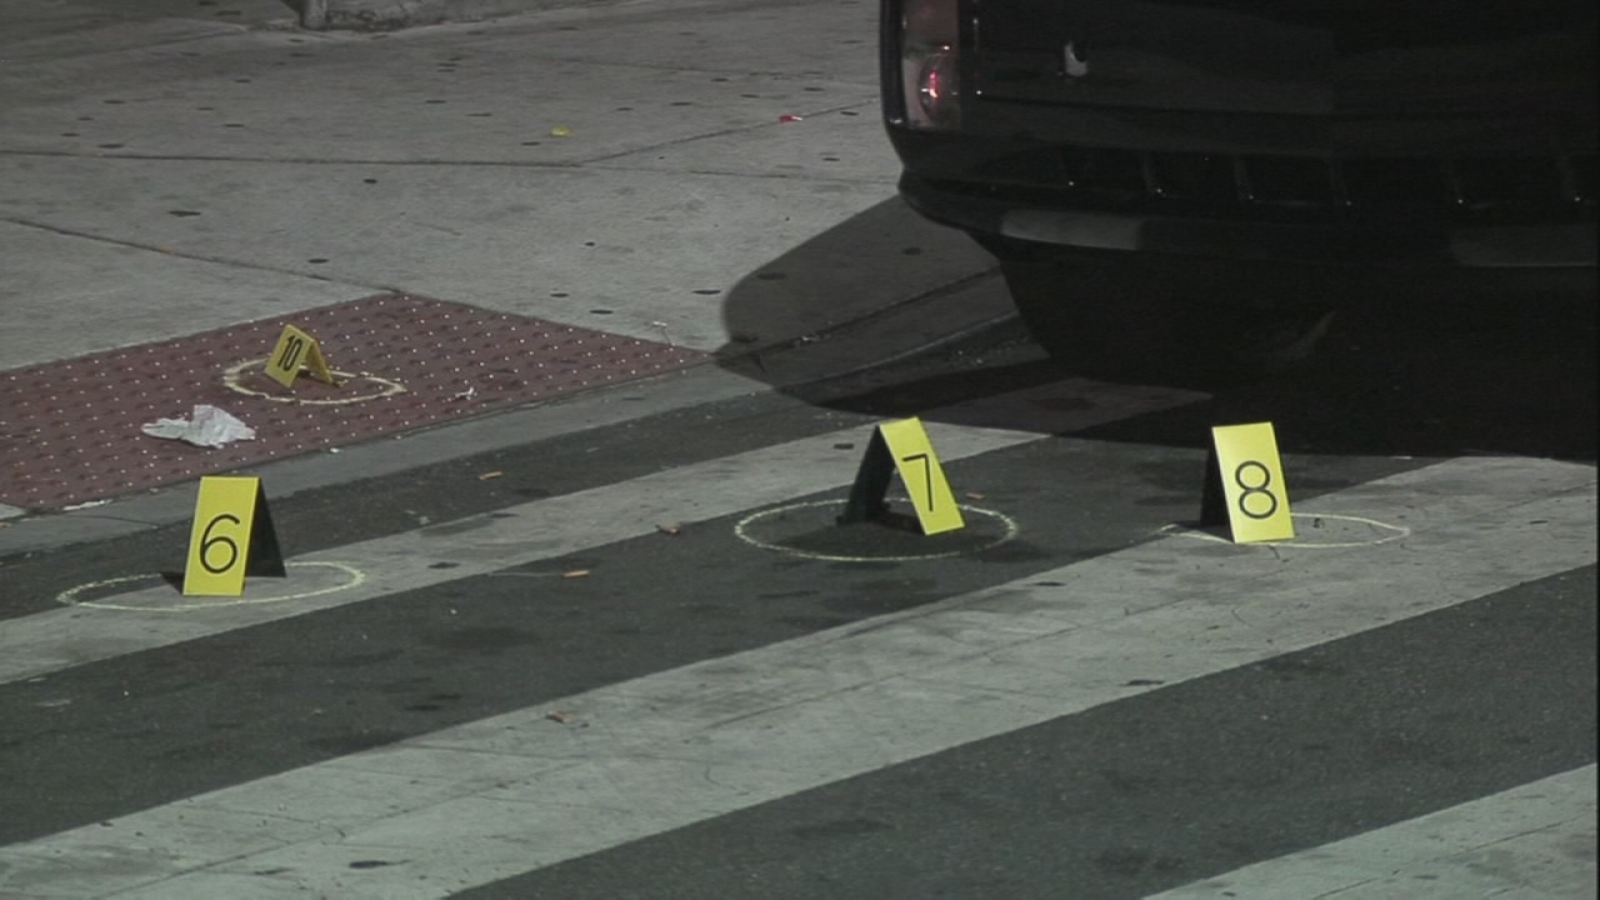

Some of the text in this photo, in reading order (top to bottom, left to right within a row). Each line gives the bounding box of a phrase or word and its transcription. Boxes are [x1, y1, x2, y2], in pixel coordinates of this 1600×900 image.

[277, 335, 303, 372] 10
[902, 453, 933, 512] 7
[1235, 460, 1277, 519] 8
[200, 514, 240, 574] 6
